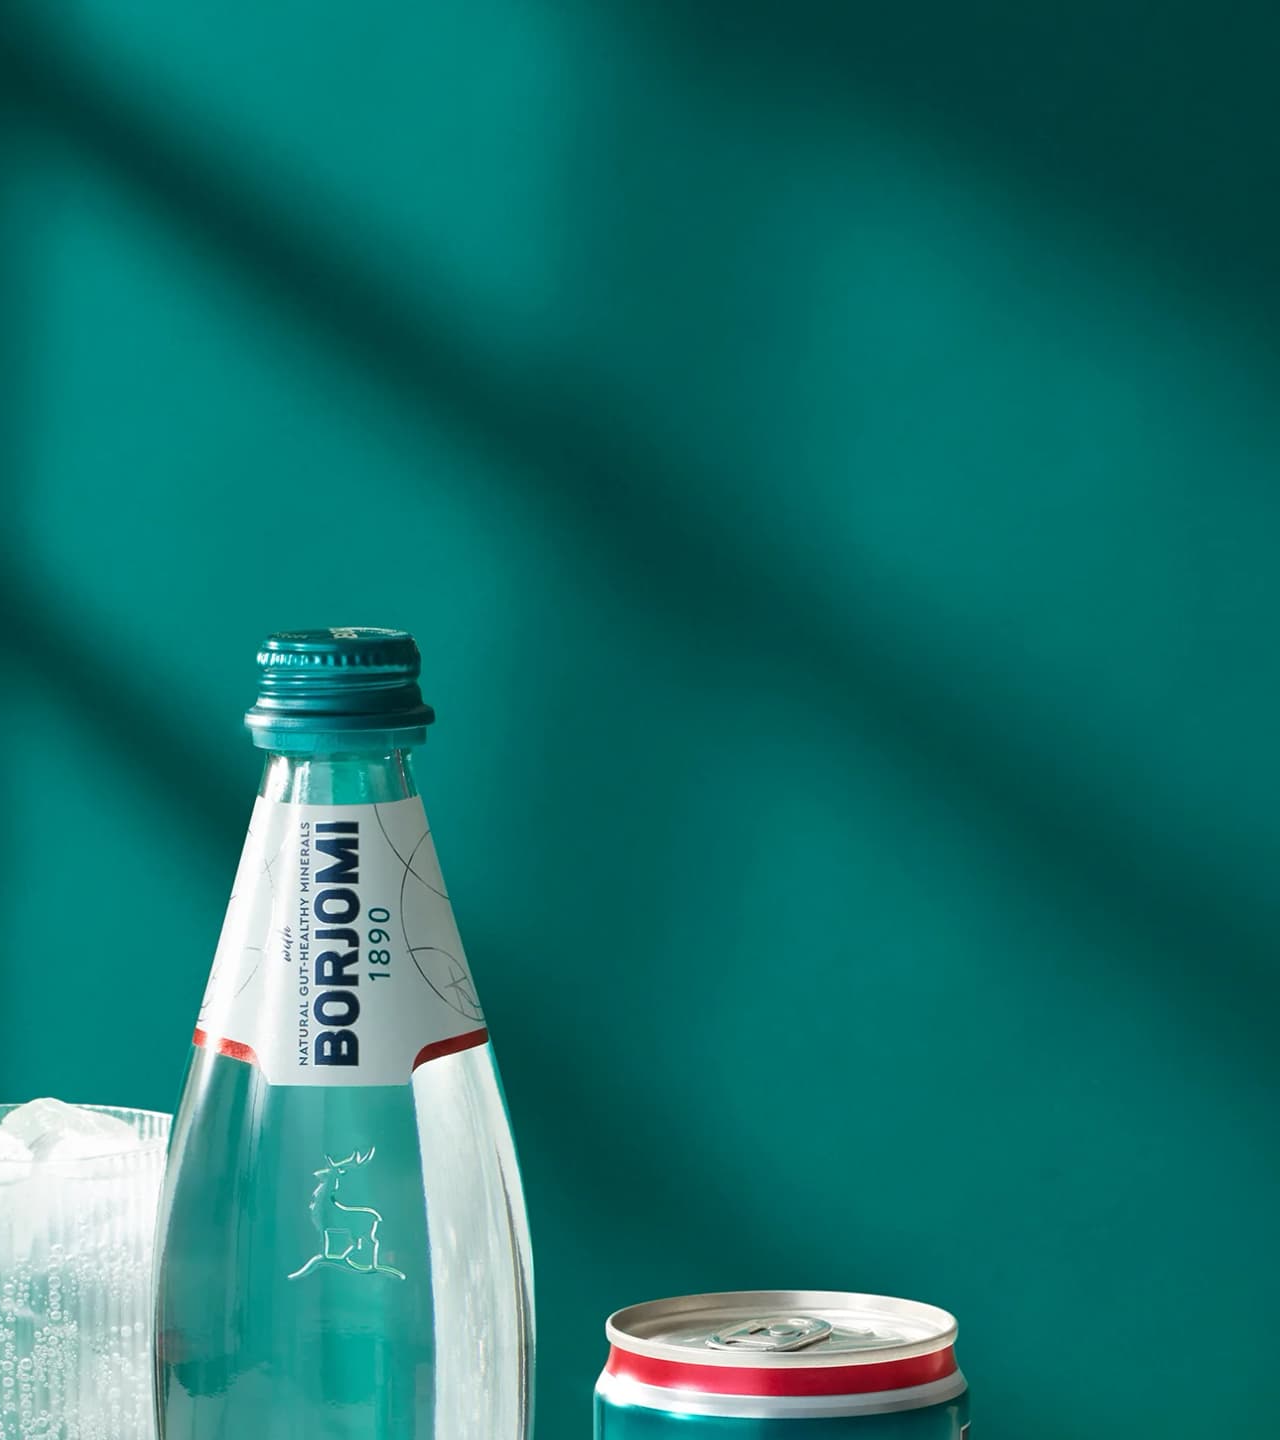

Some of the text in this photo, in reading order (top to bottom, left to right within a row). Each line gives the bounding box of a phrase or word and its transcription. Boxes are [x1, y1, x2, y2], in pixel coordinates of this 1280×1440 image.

[299, 821, 310, 1066] NATURAL GUT-HEALTHY MINERALS
[313, 821, 361, 1067] BORJOMI
[368, 907, 391, 981] 1890
